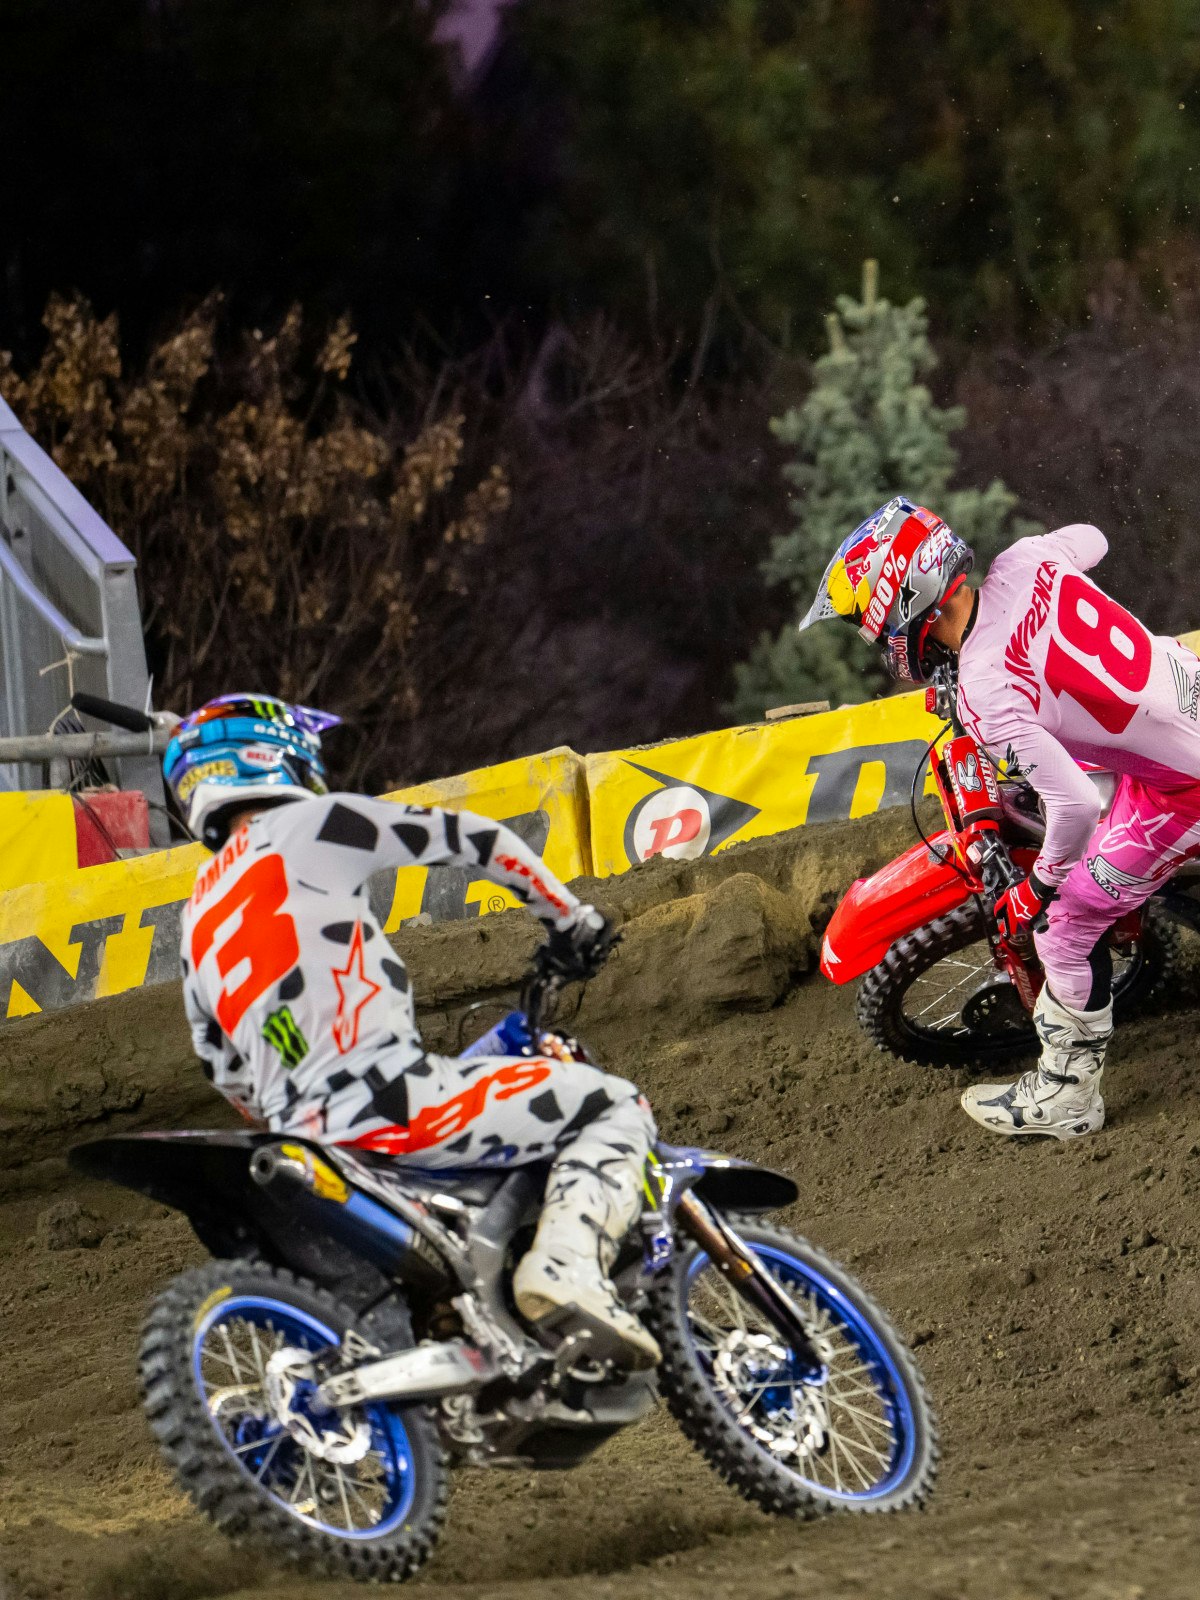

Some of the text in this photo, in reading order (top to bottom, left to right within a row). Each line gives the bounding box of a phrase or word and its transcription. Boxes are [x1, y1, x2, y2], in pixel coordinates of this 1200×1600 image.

[1004, 560, 1060, 715] LAWRENCE
[1044, 574, 1152, 735] 18
[975, 742, 999, 804] RENTHA
[191, 852, 300, 1040] 3
[1086, 857, 1121, 901] HONDA
